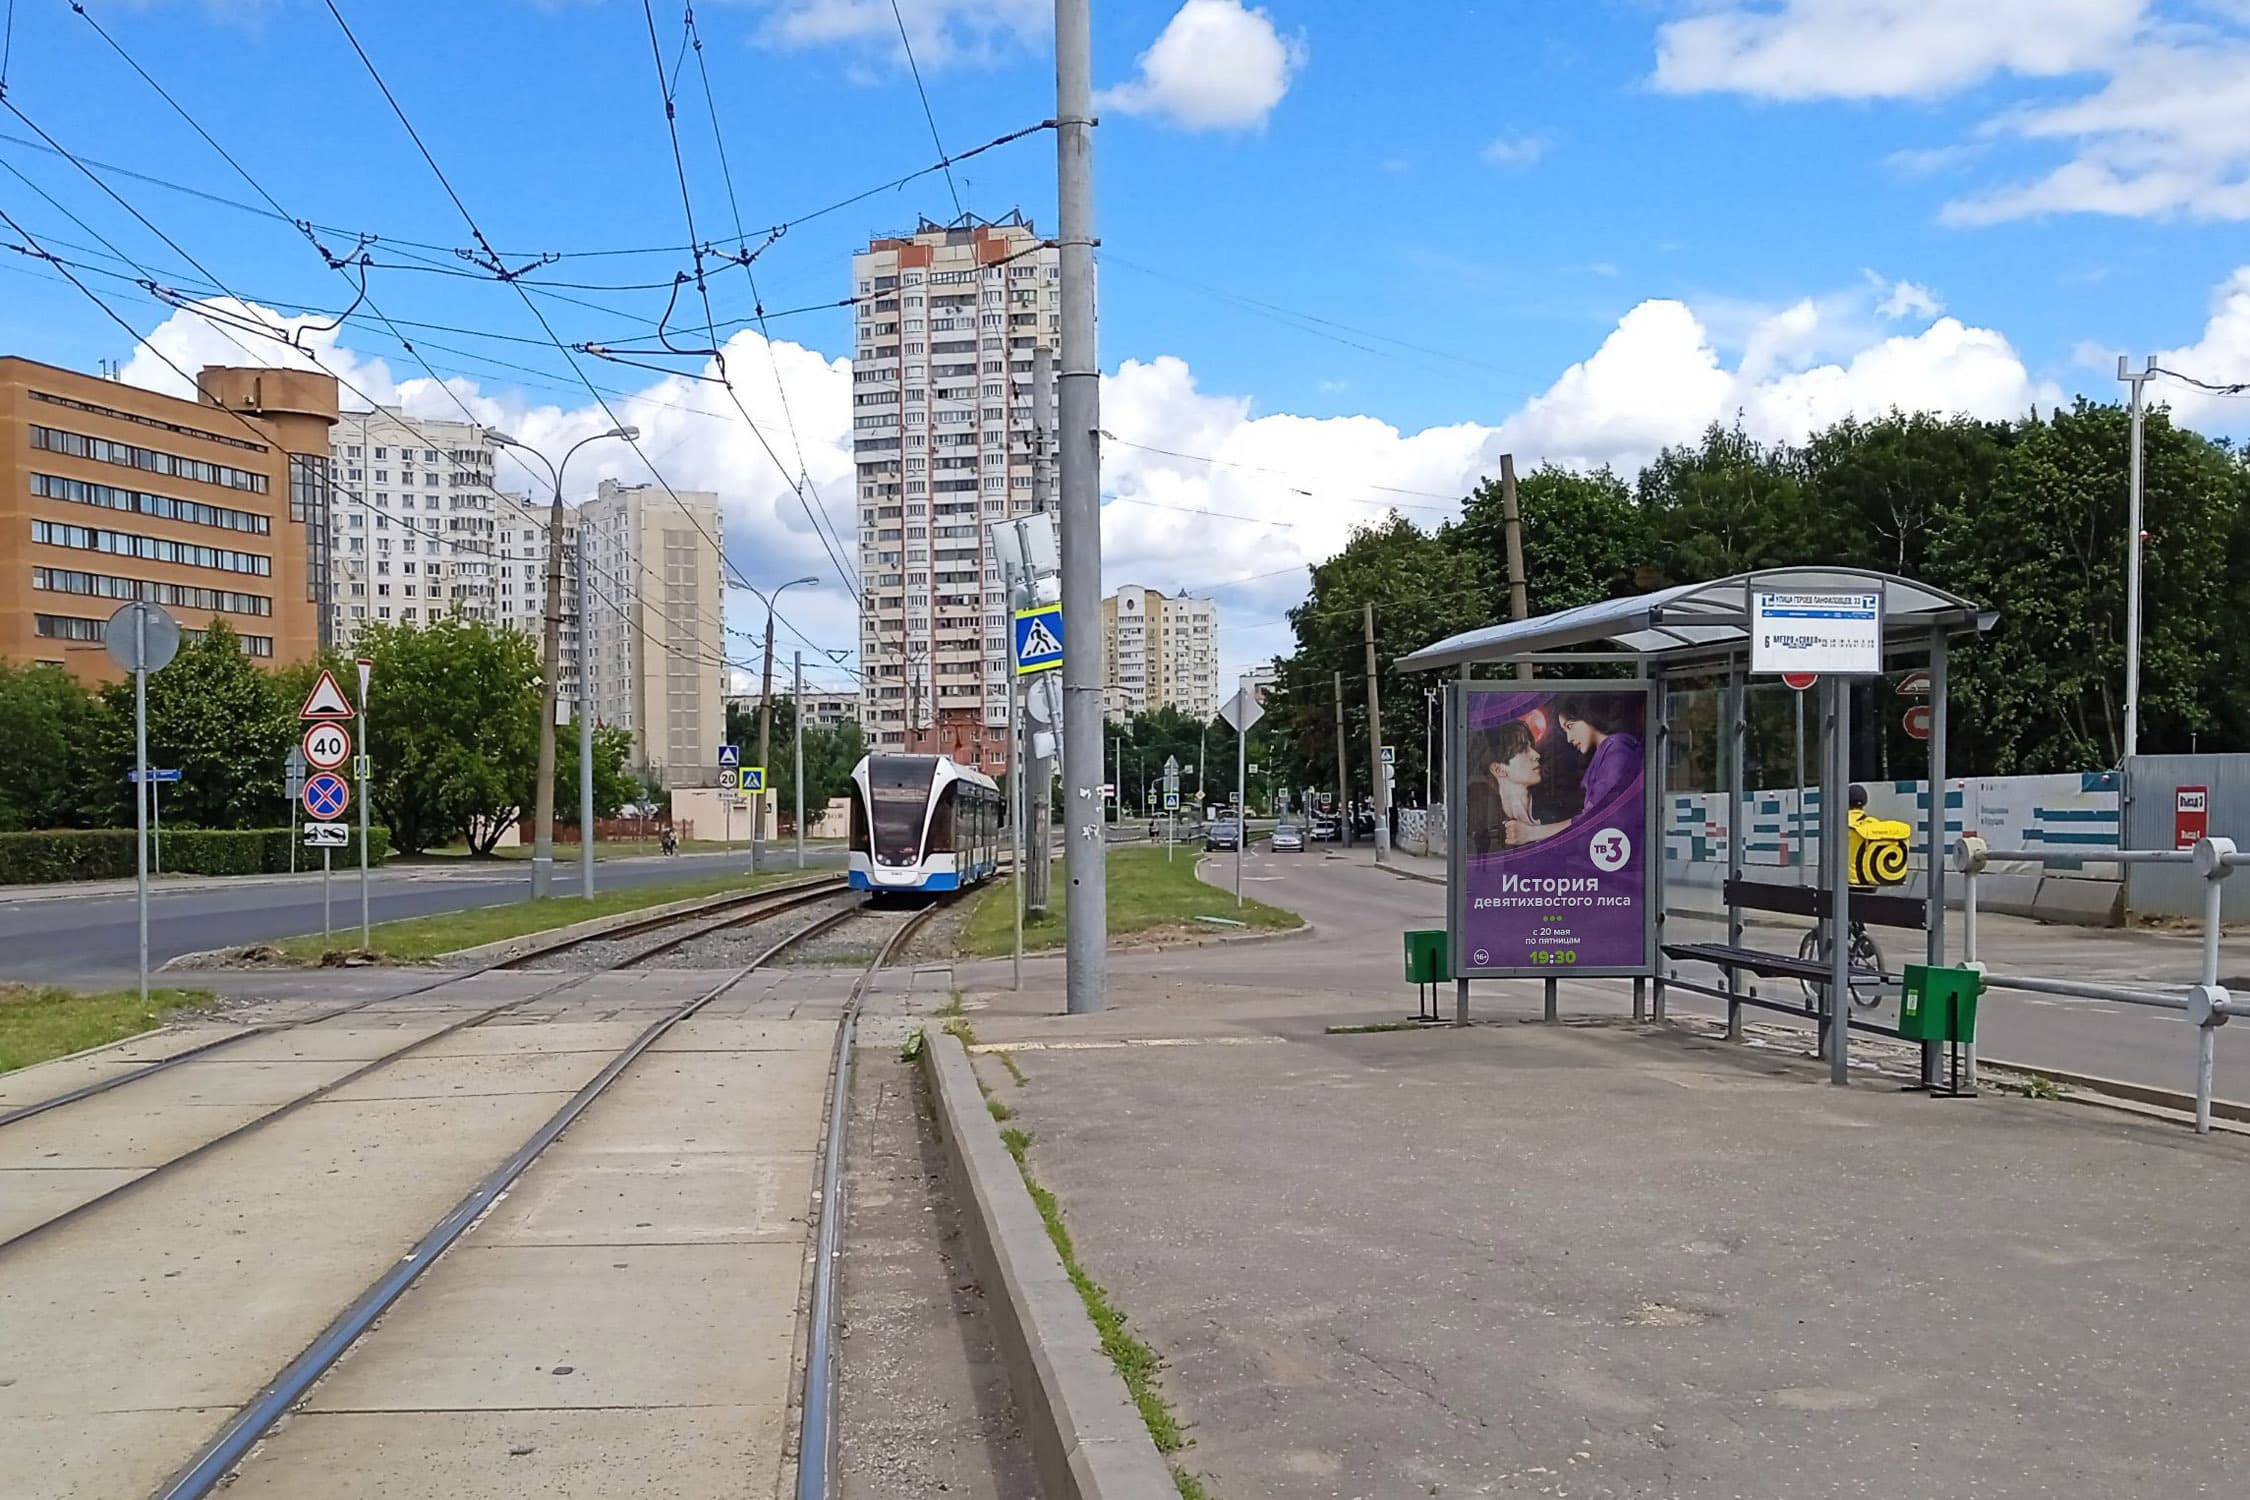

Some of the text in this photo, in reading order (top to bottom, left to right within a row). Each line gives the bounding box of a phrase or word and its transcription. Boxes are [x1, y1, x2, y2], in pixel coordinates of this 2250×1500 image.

[1764, 636, 1770, 648] 6
[313, 737, 341, 756] 40
[722, 774, 735, 784] 20
[1502, 874, 1599, 896] История
[1474, 896, 1631, 909] девятихвостого лиса
[1540, 928, 1552, 936] 20
[1538, 937, 1581, 946] пятницам
[1476, 952, 1488, 961] 16+
[1530, 950, 1576, 964] 19:30
